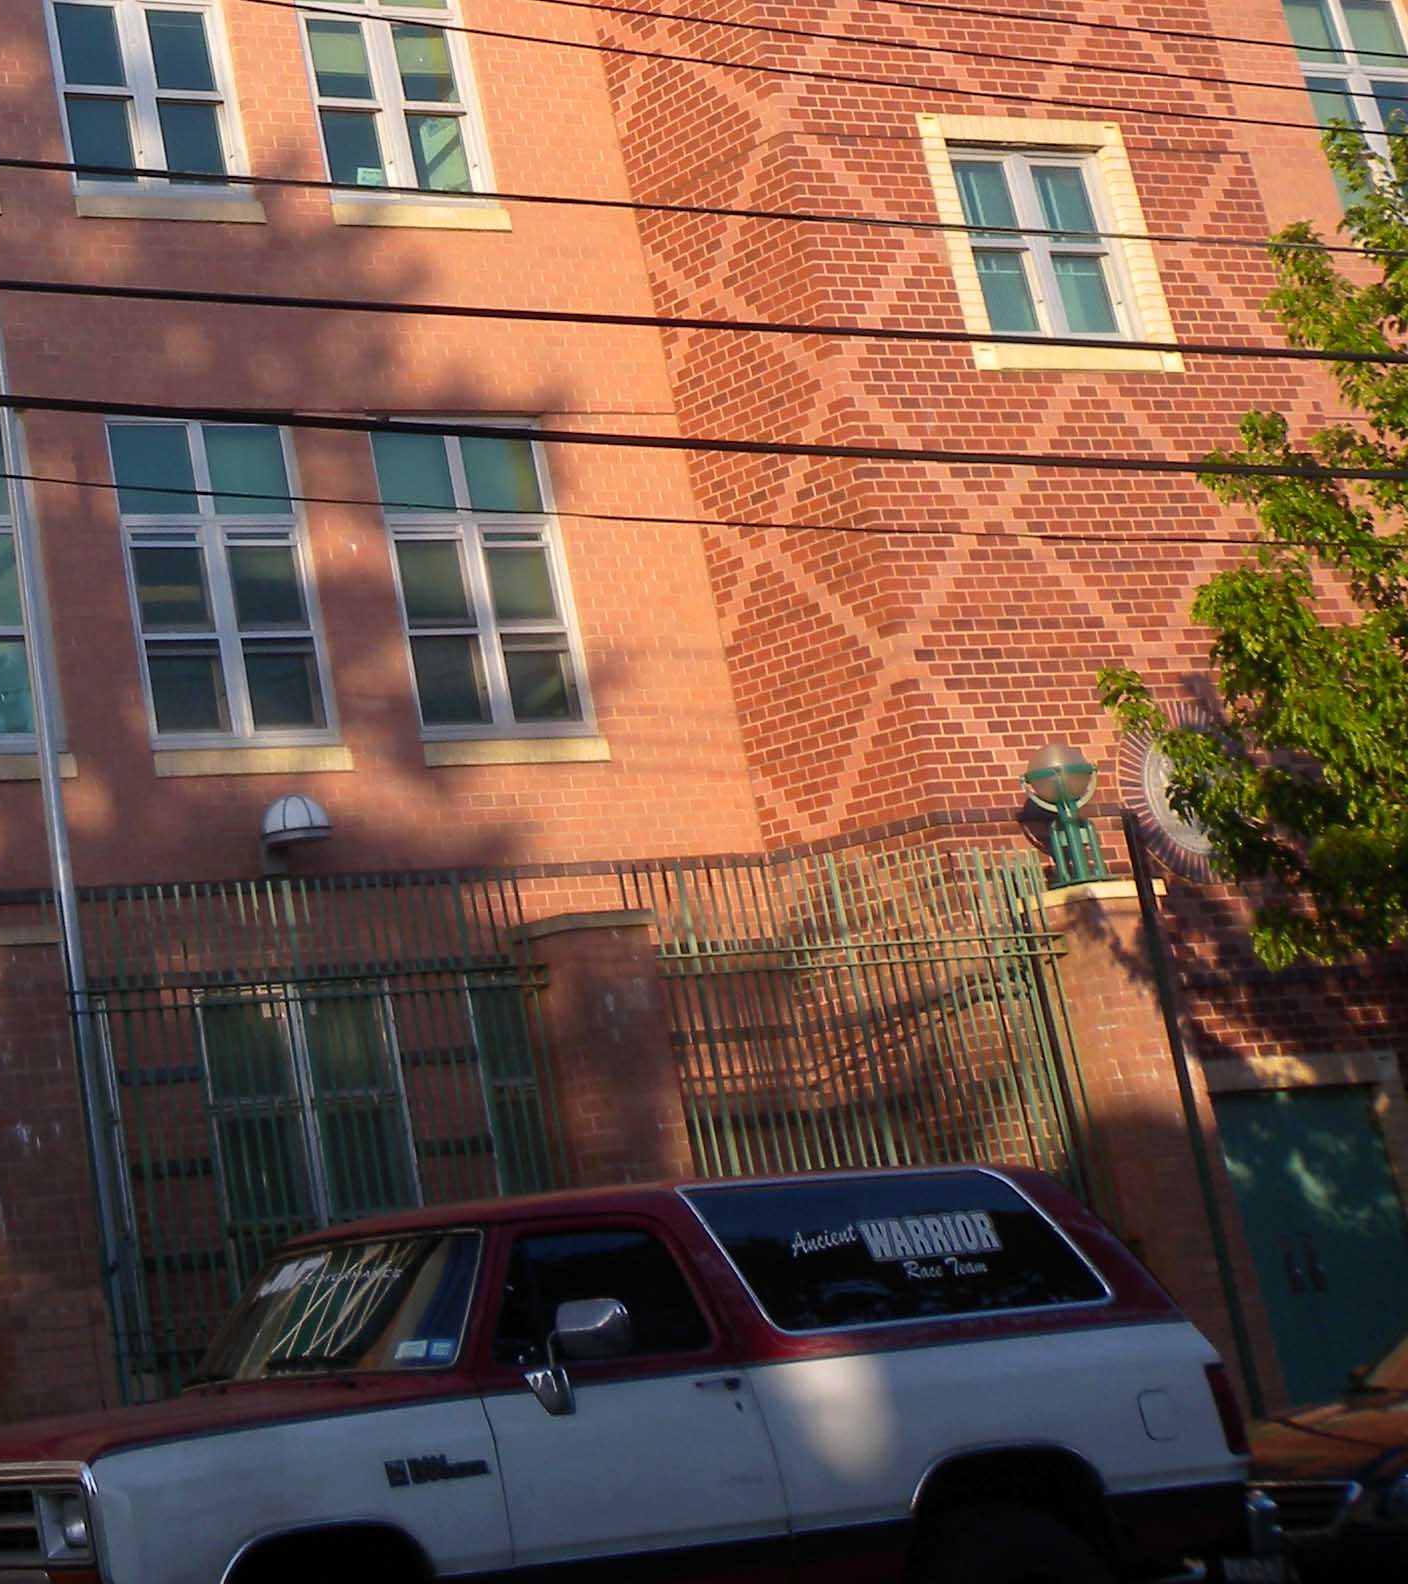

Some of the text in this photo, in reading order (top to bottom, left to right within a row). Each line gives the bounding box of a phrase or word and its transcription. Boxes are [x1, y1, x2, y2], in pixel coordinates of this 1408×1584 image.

[791, 1211, 1002, 1261] Ancient WARRIOR
[903, 1256, 988, 1280] Race Team
